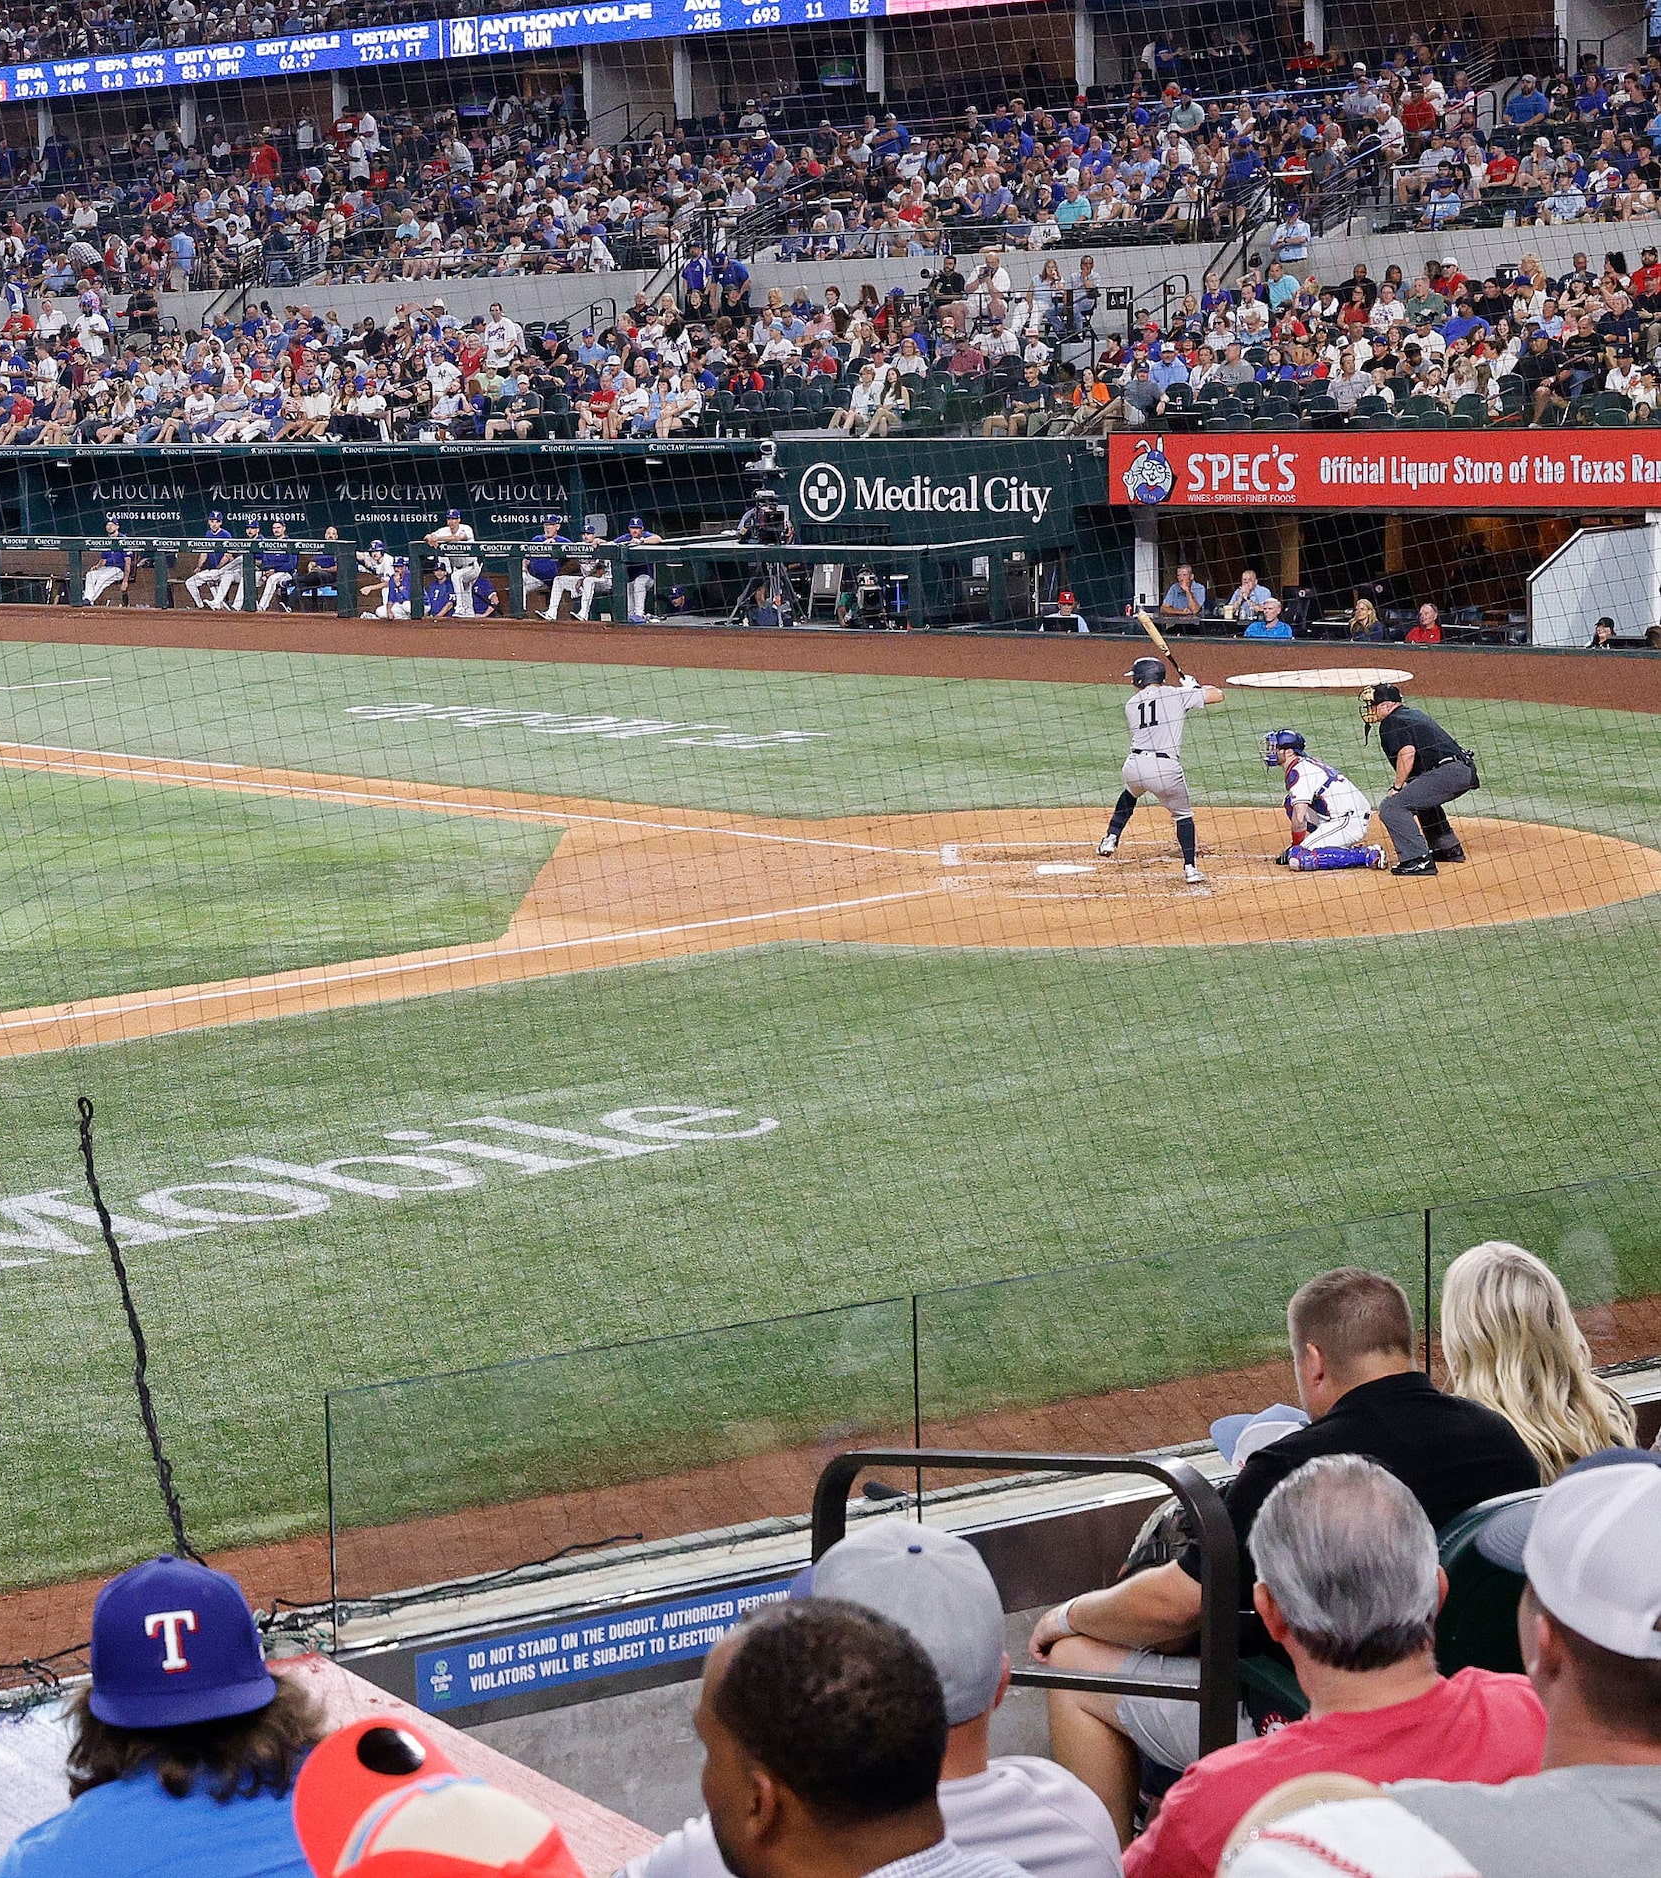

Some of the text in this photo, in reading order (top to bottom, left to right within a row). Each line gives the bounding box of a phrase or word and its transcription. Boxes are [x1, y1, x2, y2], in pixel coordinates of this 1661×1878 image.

[480, 3, 652, 36] ANTHONY VOLPE
[688, 6, 781, 31] .255 .693
[256, 35, 341, 56] EXIT ANGLE
[352, 26, 430, 47] DISTANCE
[480, 30, 552, 53] 1-1, RUN
[174, 46, 246, 64] EXIT VELO
[359, 41, 422, 62] 173.4 FT
[54, 62, 90, 77] WHIP
[95, 59, 128, 73] BB%
[131, 54, 165, 69] SO%
[181, 61, 240, 80] 83.9 MPH
[16, 68, 44, 81] ERA
[101, 73, 124, 89] 8.8
[135, 69, 164, 85] 14.3
[14, 81, 49, 98] 10.70
[58, 77, 87, 93] 2.04
[540, 444, 576, 453] CHOCTAW
[648, 443, 685, 452] CHOCTAW
[1187, 444, 1299, 492] SPEC'S
[1320, 456, 1385, 484] Official
[1391, 455, 1449, 490] Liquor
[1453, 455, 1504, 484] Store
[1509, 455, 1529, 484] of
[1533, 455, 1565, 484] the
[1570, 454, 1626, 484] Texas
[95, 483, 186, 501] CHOCTAW
[213, 483, 311, 501] CHOCTAW
[341, 482, 443, 501] CHOCTAW
[854, 475, 1052, 524] Medical City
[1245, 494, 1267, 502] FINER
[1270, 494, 1297, 503] FOODS
[106, 512, 181, 521] CASINOS & RESORTS
[227, 512, 306, 522] CASINOS & RESORTS
[354, 513, 439, 523] CASINOS & RESORTS
[491, 514, 538, 524] CASINOS &
[1138, 699, 1159, 730] 11
[143, 1608, 198, 1673] T
[468, 1652, 486, 1670] DO
[489, 1645, 515, 1666] NOT
[517, 1636, 558, 1660] STAND
[561, 1632, 579, 1650] ON
[582, 1626, 606, 1646] THE
[608, 1616, 659, 1641] DUGOUT.
[661, 1600, 734, 1630] AUTHORIZED
[470, 1664, 536, 1693] VIOLATORS
[539, 1656, 570, 1678] WILL
[573, 1652, 589, 1671] BE
[592, 1641, 646, 1667] SUBJECT
[649, 1637, 665, 1655] TO
[668, 1625, 725, 1651] EJECTION
